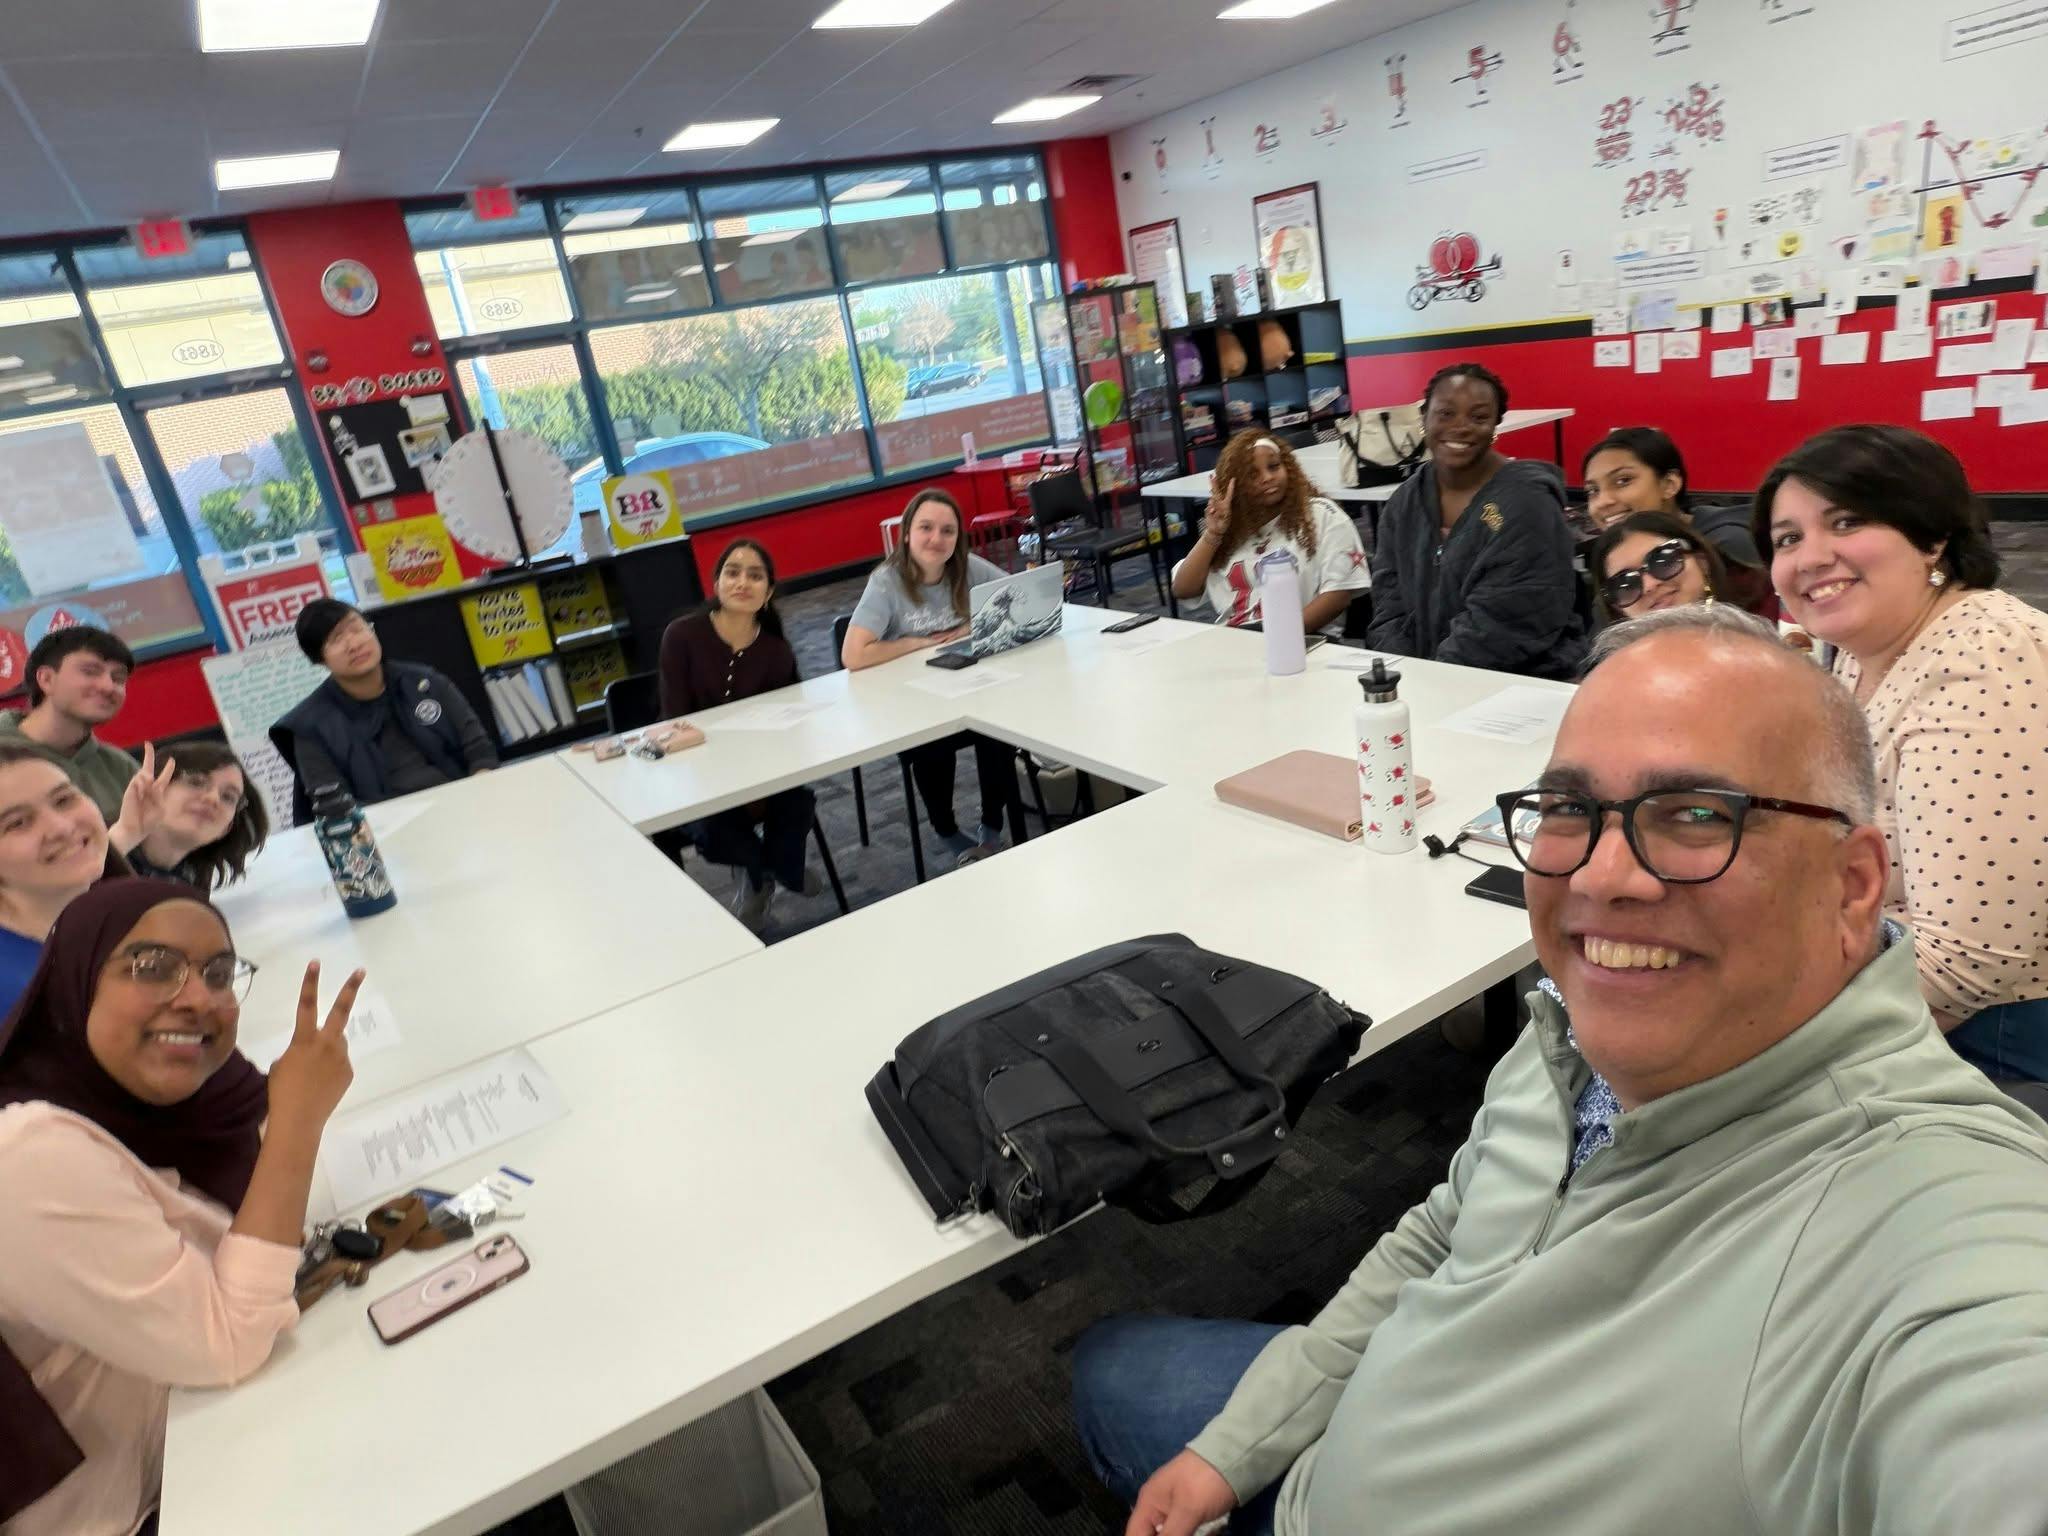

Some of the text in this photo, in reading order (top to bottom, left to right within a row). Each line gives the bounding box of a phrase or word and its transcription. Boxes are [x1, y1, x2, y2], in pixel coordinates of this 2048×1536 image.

[1554, 21, 1572, 56] 6
[1598, 96, 1632, 131] 23
[616, 489, 664, 516] BR
[479, 590, 520, 608] You're
